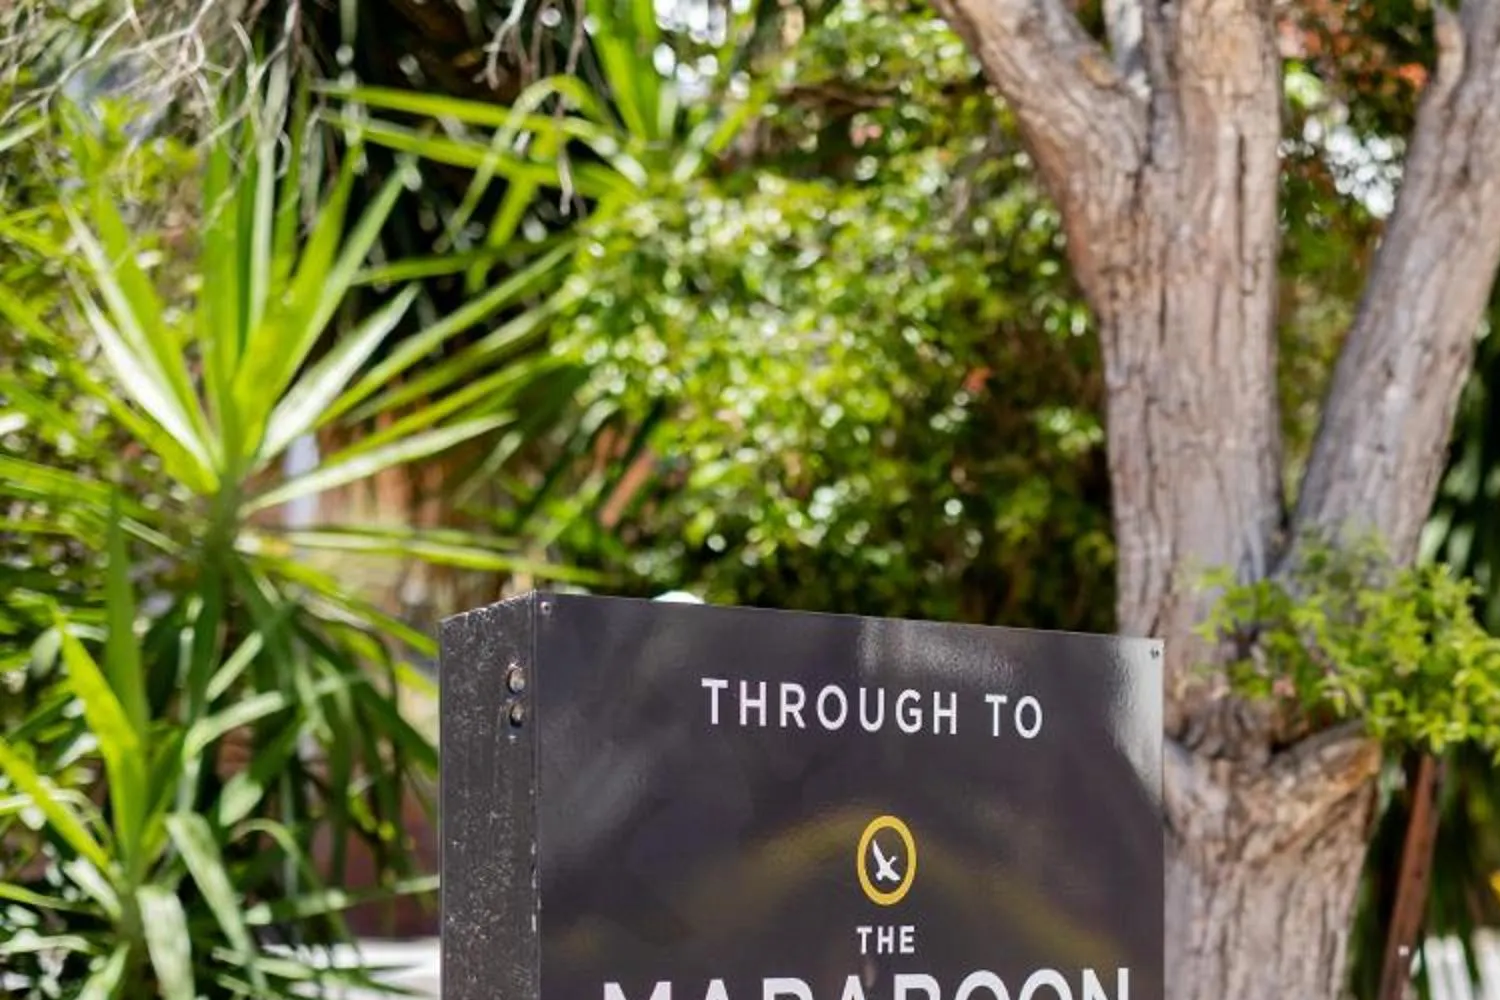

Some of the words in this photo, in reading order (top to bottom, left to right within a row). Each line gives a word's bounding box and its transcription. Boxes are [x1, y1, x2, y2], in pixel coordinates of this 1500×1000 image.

[701, 677, 958, 735] THROUGH
[985, 693, 1043, 740] TO
[856, 924, 915, 956] THE
